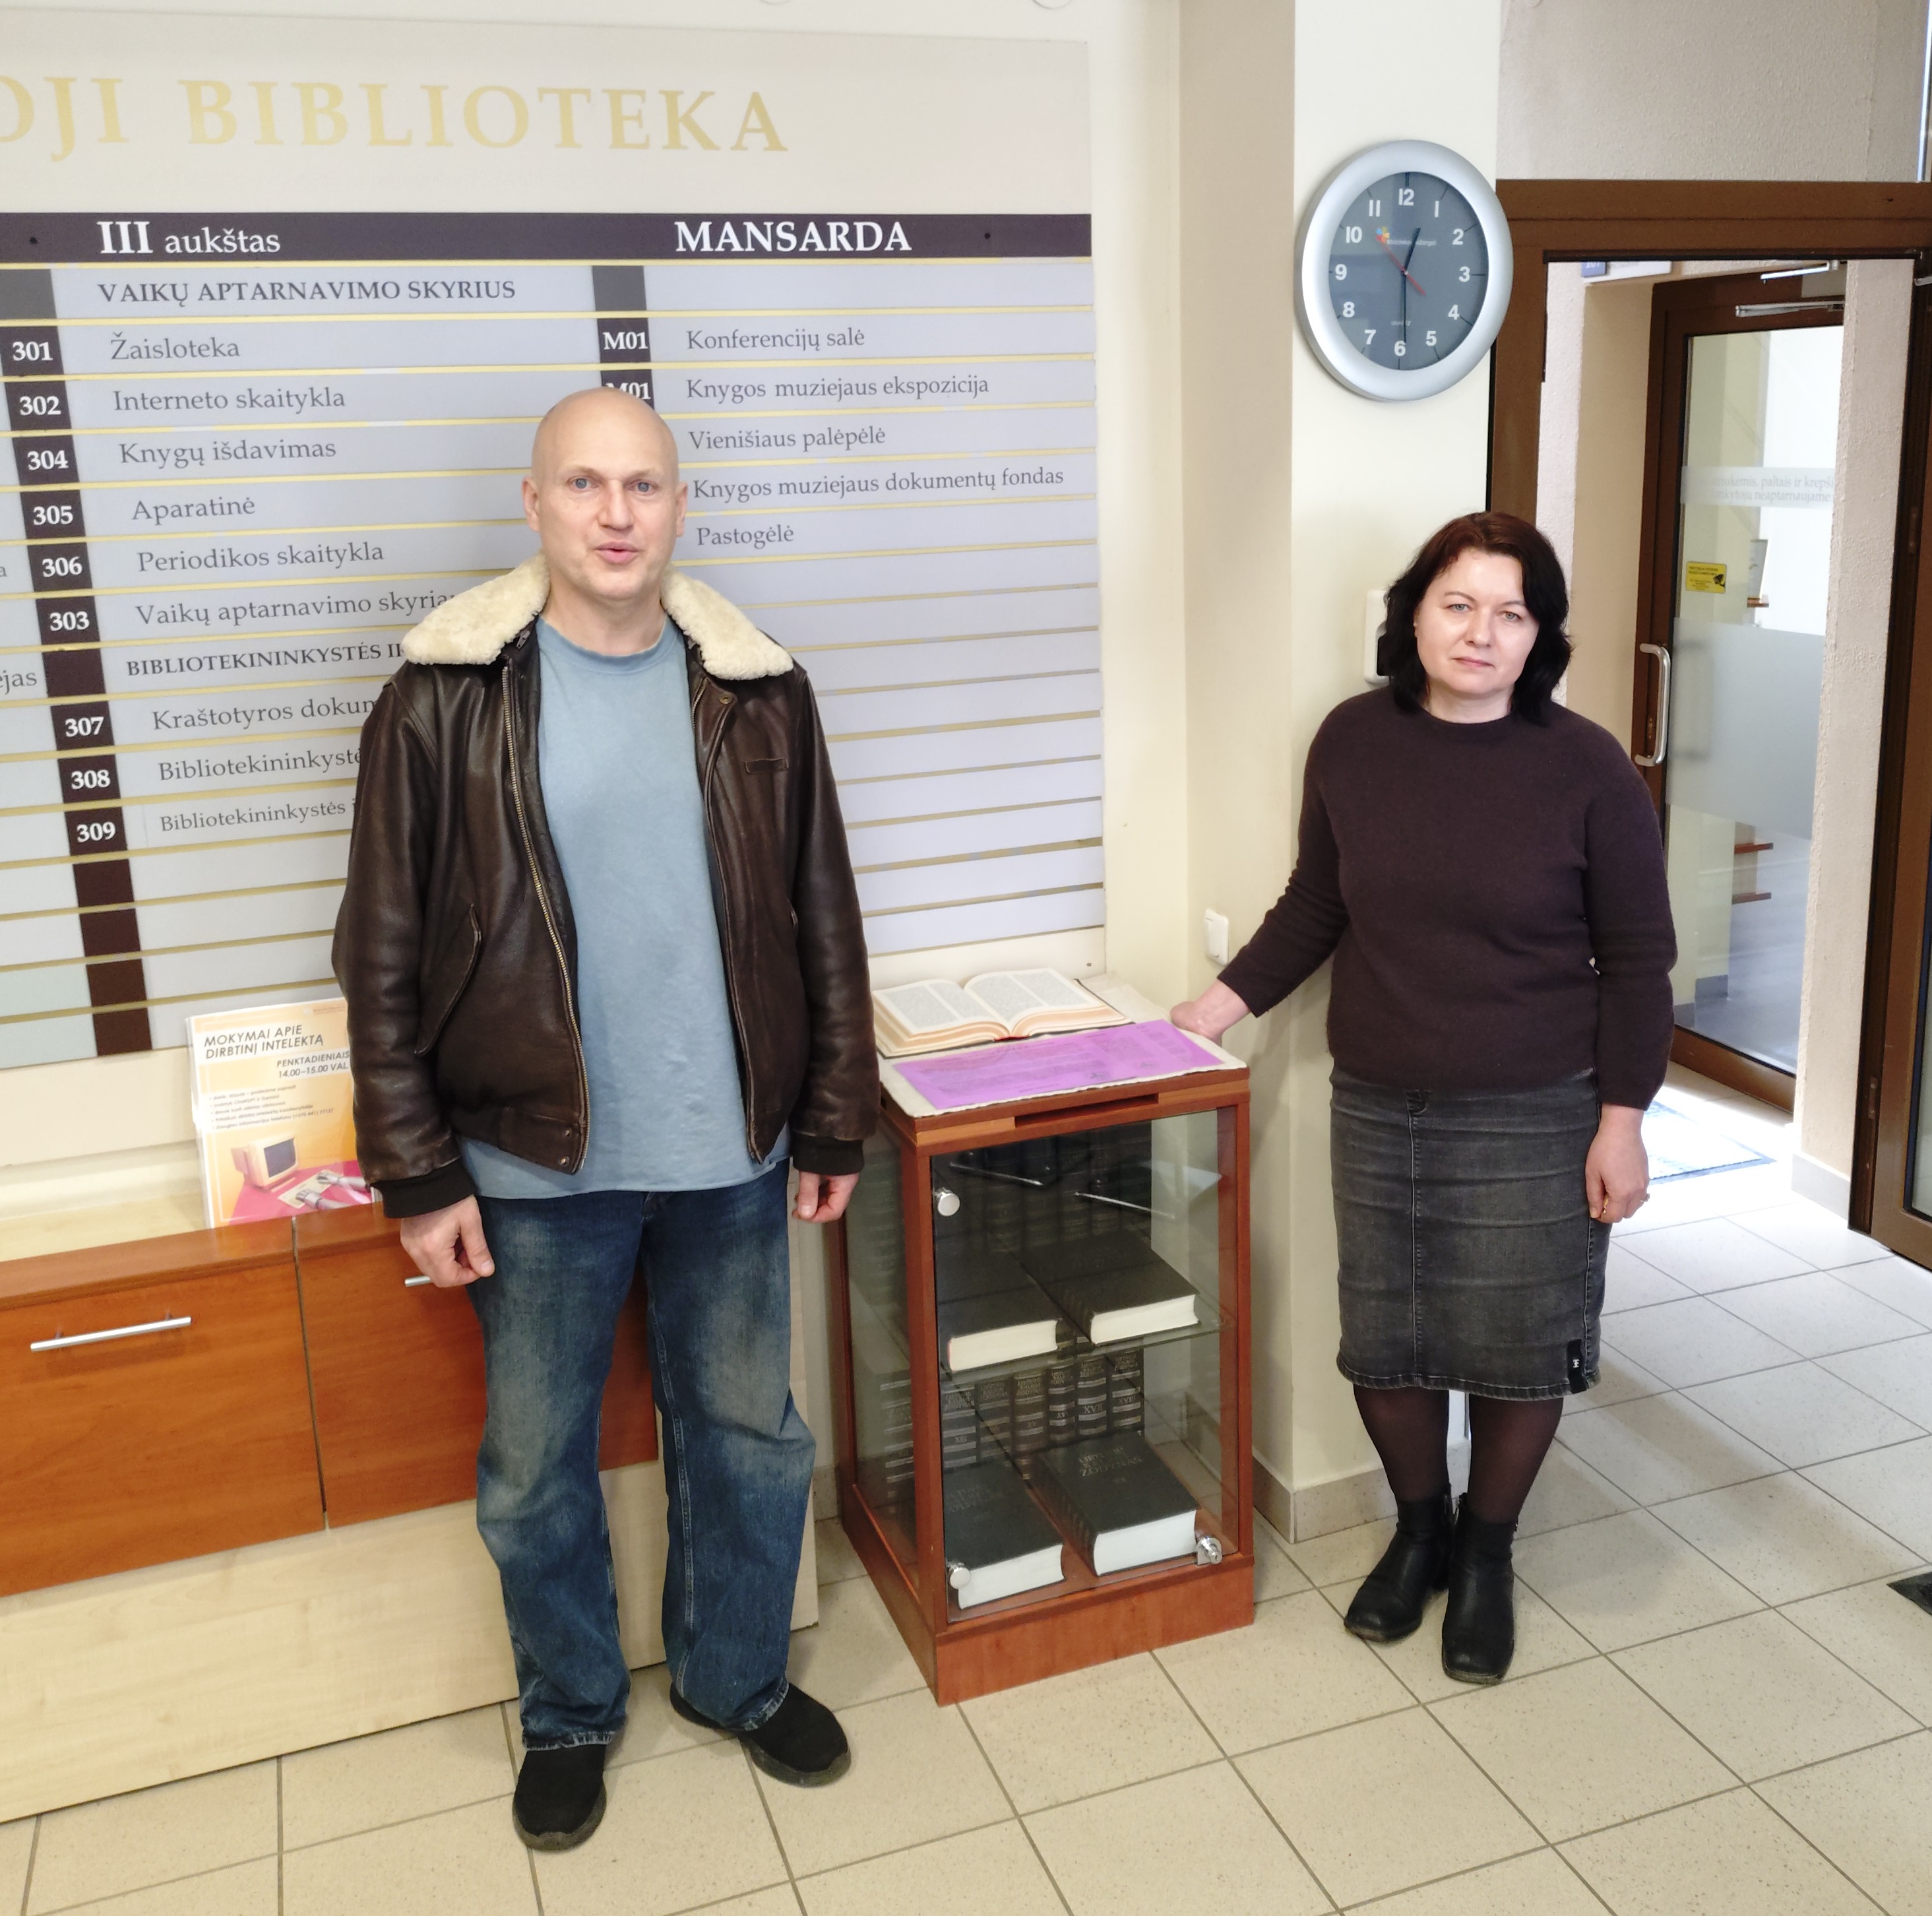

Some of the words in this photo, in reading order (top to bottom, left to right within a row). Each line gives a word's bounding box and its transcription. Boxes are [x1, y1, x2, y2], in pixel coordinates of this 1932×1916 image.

[178, 80, 788, 152] BIBLIOTEKA
[1368, 199, 1381, 217] 11
[1398, 188, 1415, 207] 12
[1434, 201, 1439, 218] 1
[96, 221, 154, 254] III
[165, 226, 281, 253] aukštas
[674, 221, 912, 252] MANSARDA
[1346, 226, 1363, 243] 10
[1452, 228, 1464, 245] 2
[1335, 263, 1348, 280] 9
[1458, 266, 1470, 282] 3
[97, 283, 188, 307] VAIKŲ
[198, 281, 400, 301] APTARNAVIMO
[408, 280, 516, 299] SKYRIUS
[1342, 301, 1355, 318] 8
[1448, 304, 1460, 321] 4
[110, 331, 241, 360] Žaisloteka
[602, 331, 648, 350] M01
[686, 329, 820, 352] Konferencijų
[826, 327, 865, 346] salė
[1364, 329, 1377, 345] 7
[1425, 330, 1437, 346] 5
[13, 341, 53, 361] 301
[1394, 340, 1407, 357] 6
[686, 379, 766, 404] Knygos
[775, 377, 877, 402] muziejaus
[883, 374, 989, 400] ekspozicija
[20, 395, 61, 416] 302
[113, 391, 228, 411] Interneto
[235, 387, 346, 415] skaitykla
[687, 430, 796, 449] Vienišiaus
[802, 426, 886, 453] palėpėlė
[27, 449, 69, 470] 304
[119, 443, 205, 470] Knygų
[212, 439, 336, 461] išdavimas
[693, 480, 772, 503] Knygos
[778, 475, 879, 499] muziejaus
[885, 472, 996, 491] dokumentų
[1002, 466, 1064, 486] fondas
[1761, 475, 1792, 490] paltais
[33, 505, 74, 526] 305
[132, 496, 255, 526] Aparatinė
[696, 524, 794, 550] Pastogėlė
[42, 556, 82, 577] 306
[137, 547, 270, 572] Periodikos
[277, 541, 385, 569] skaitykla
[135, 602, 210, 627] Vaikų
[218, 595, 372, 622] aptarnavimo
[379, 590, 454, 616] skyria
[49, 611, 90, 631] 303
[127, 641, 381, 677] BIBLIOTEKININKYSTĖS
[65, 716, 104, 738] 307
[152, 706, 294, 730] Kraštotyros
[71, 769, 111, 790] 308
[160, 800, 347, 833] Bibliotekininkystės
[77, 821, 116, 843] 309
[204, 1028, 270, 1047] MOKYMAI
[275, 1025, 303, 1038] APIE
[206, 1043, 259, 1060] DIRBTINĮ
[261, 1034, 324, 1052] INTELEKTĄ
[277, 1050, 350, 1068] PENKTADIENIAIS
